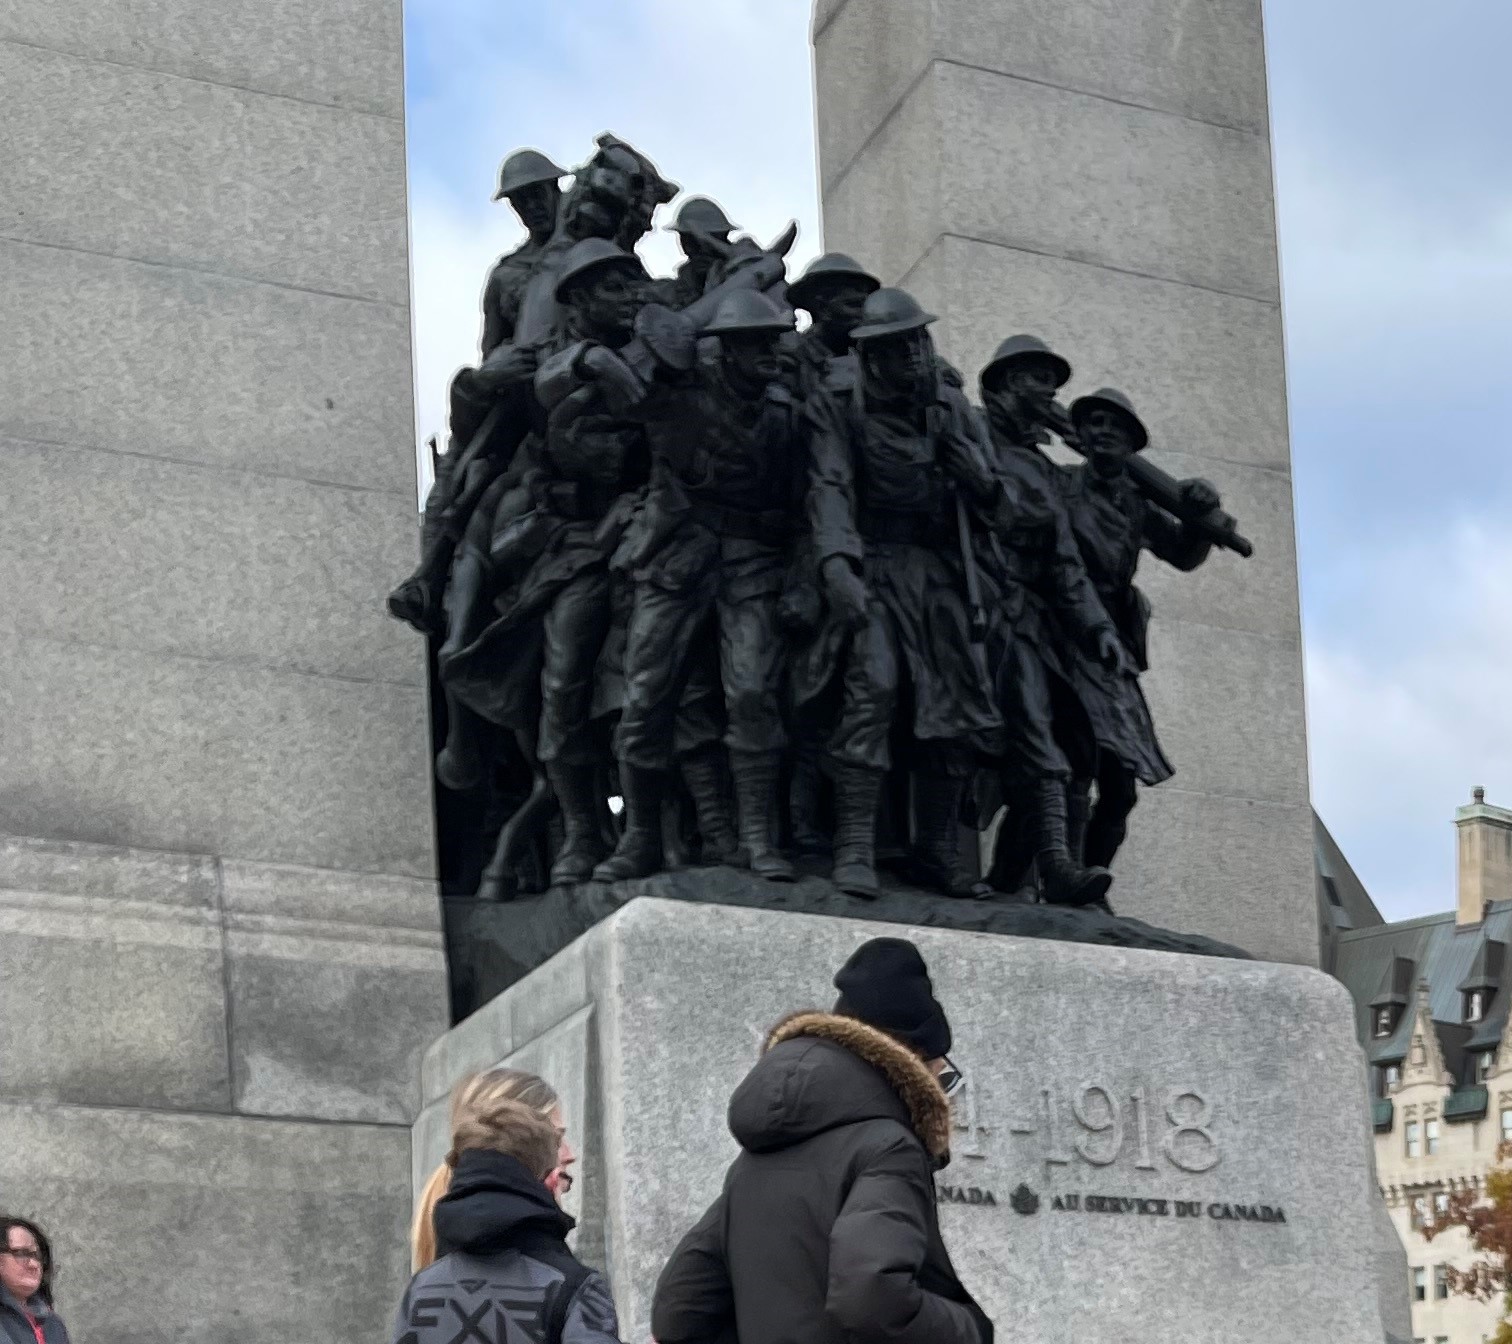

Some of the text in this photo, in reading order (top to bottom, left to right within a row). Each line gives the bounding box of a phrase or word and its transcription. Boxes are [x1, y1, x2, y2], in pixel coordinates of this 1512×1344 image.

[947, 1068, 1221, 1173] 4-1918
[937, 1186, 1287, 1223] NADA AU SERVICE DU CANADA
